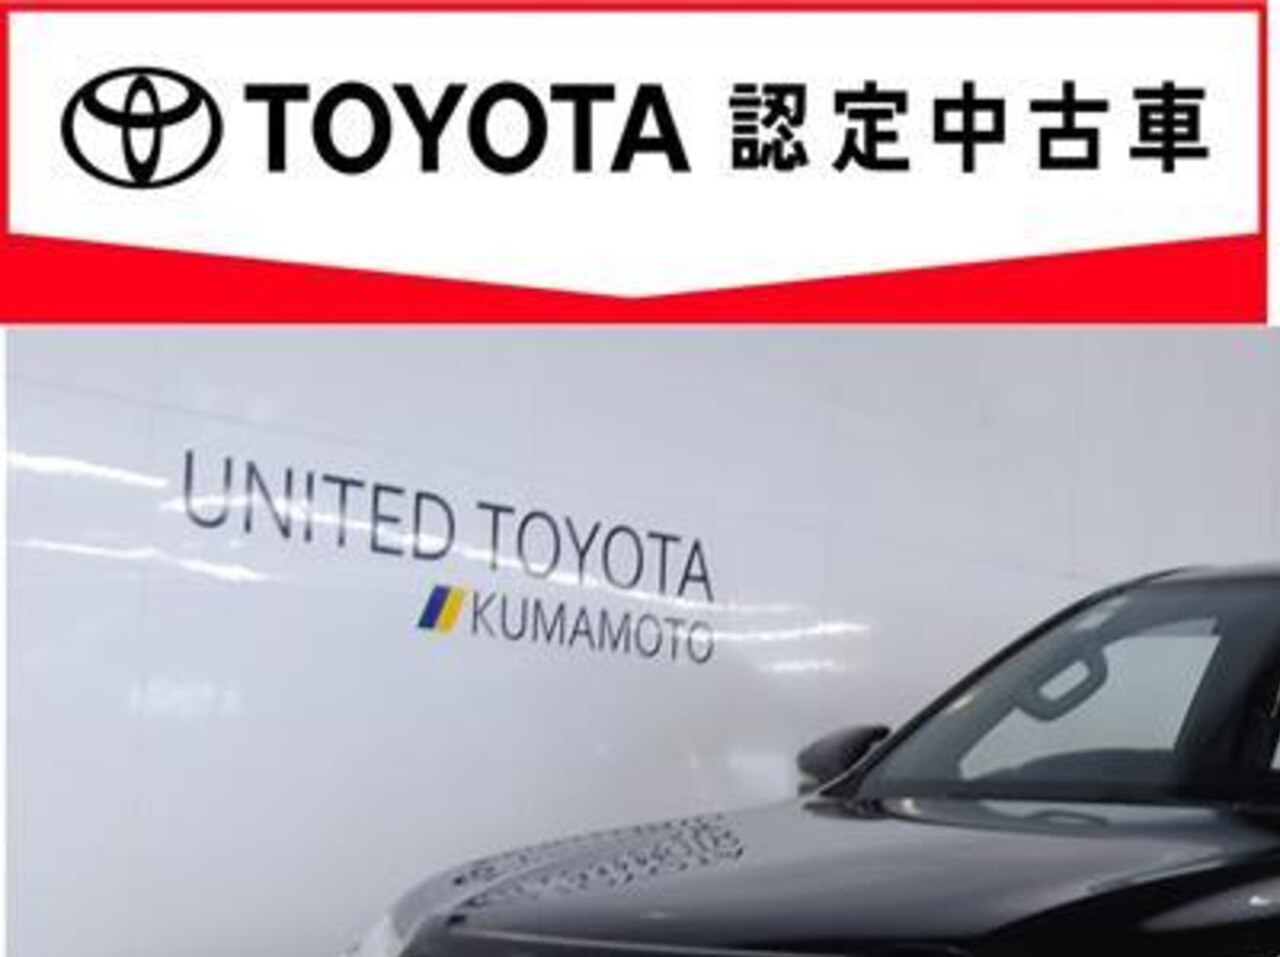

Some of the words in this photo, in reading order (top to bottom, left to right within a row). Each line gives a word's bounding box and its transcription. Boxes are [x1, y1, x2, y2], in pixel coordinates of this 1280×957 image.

[184, 451, 455, 561] UNITED
[477, 501, 715, 603] TOYOTA
[471, 590, 716, 665] KUMAMOTO
